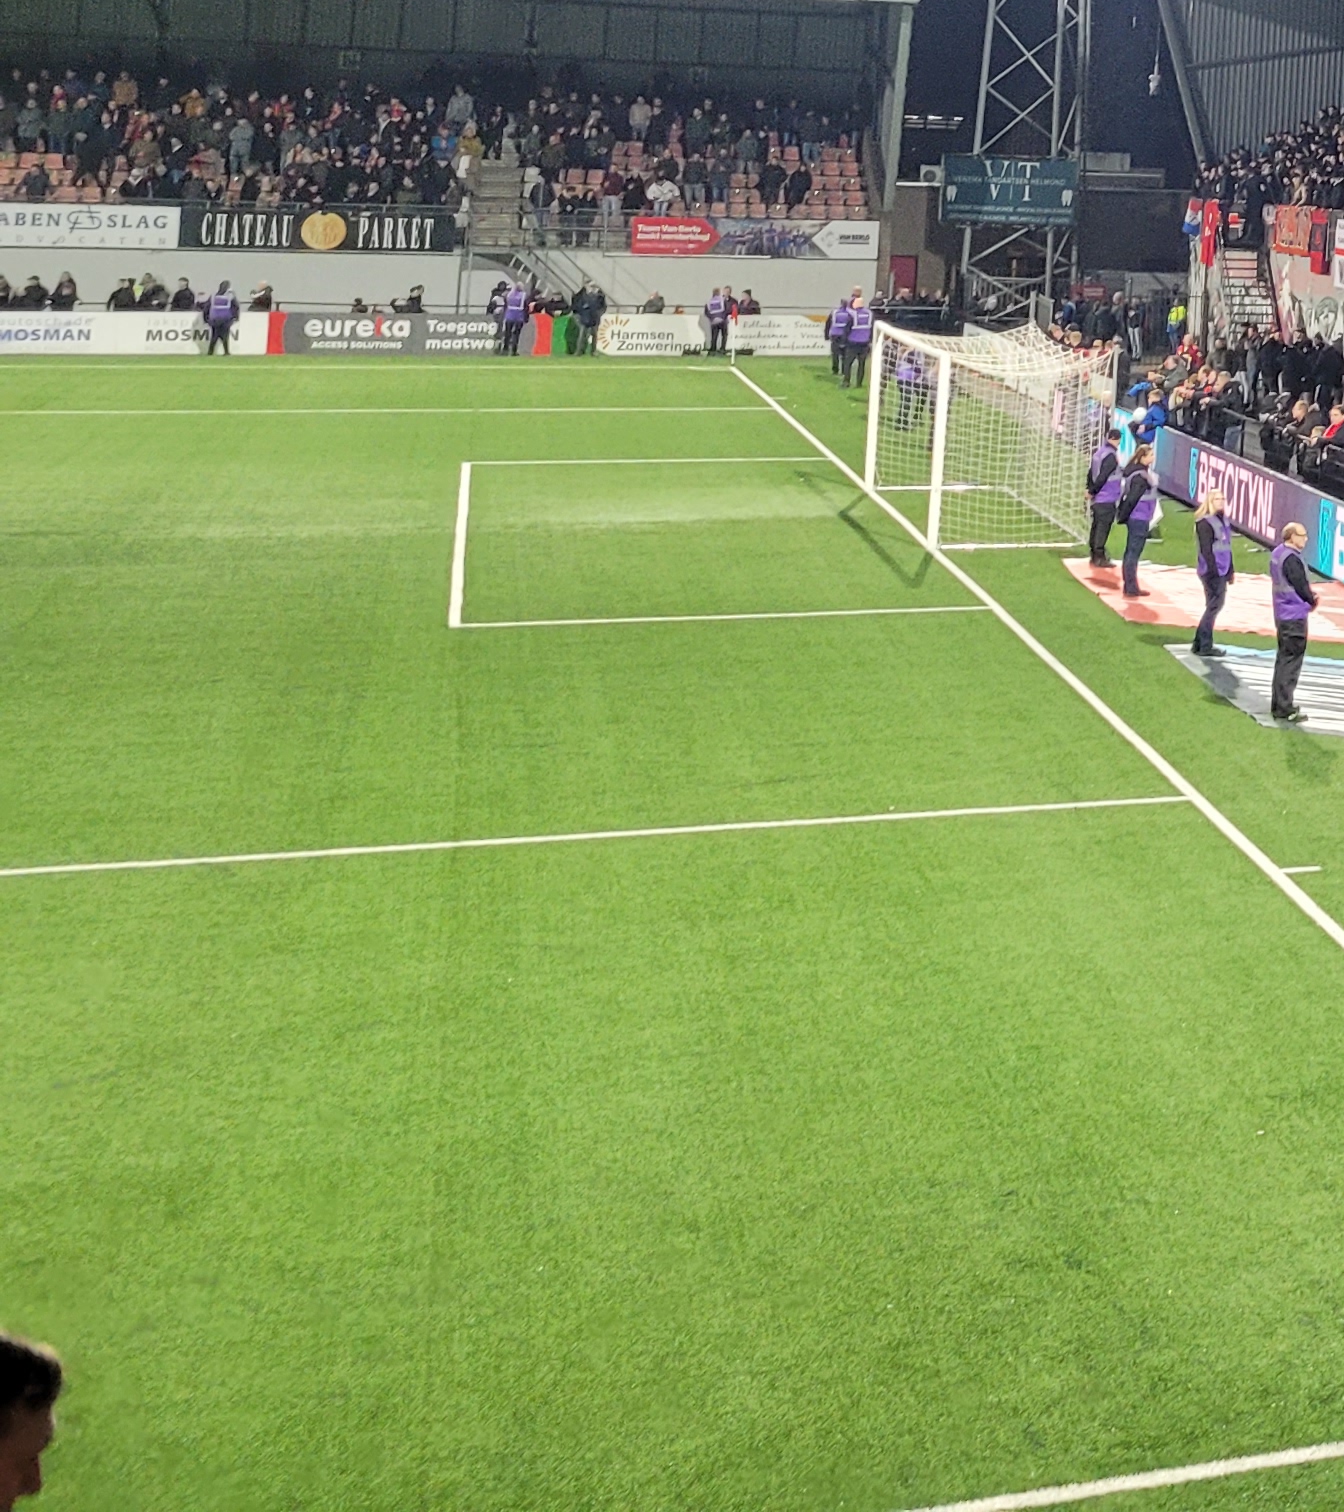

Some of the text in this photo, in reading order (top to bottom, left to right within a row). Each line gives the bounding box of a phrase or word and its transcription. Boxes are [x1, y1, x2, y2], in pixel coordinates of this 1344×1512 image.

[106, 214, 169, 230] SLAG
[201, 213, 434, 249] CHATEAU PARKET
[0, 328, 240, 342] MOSMAN MOSMN
[303, 316, 499, 339] eureka Toegang
[610, 329, 675, 341] Harmsen
[311, 340, 349, 350] ACCESS
[350, 340, 403, 350] SOLUTIONS
[1197, 450, 1277, 542] BETCITY.NL
